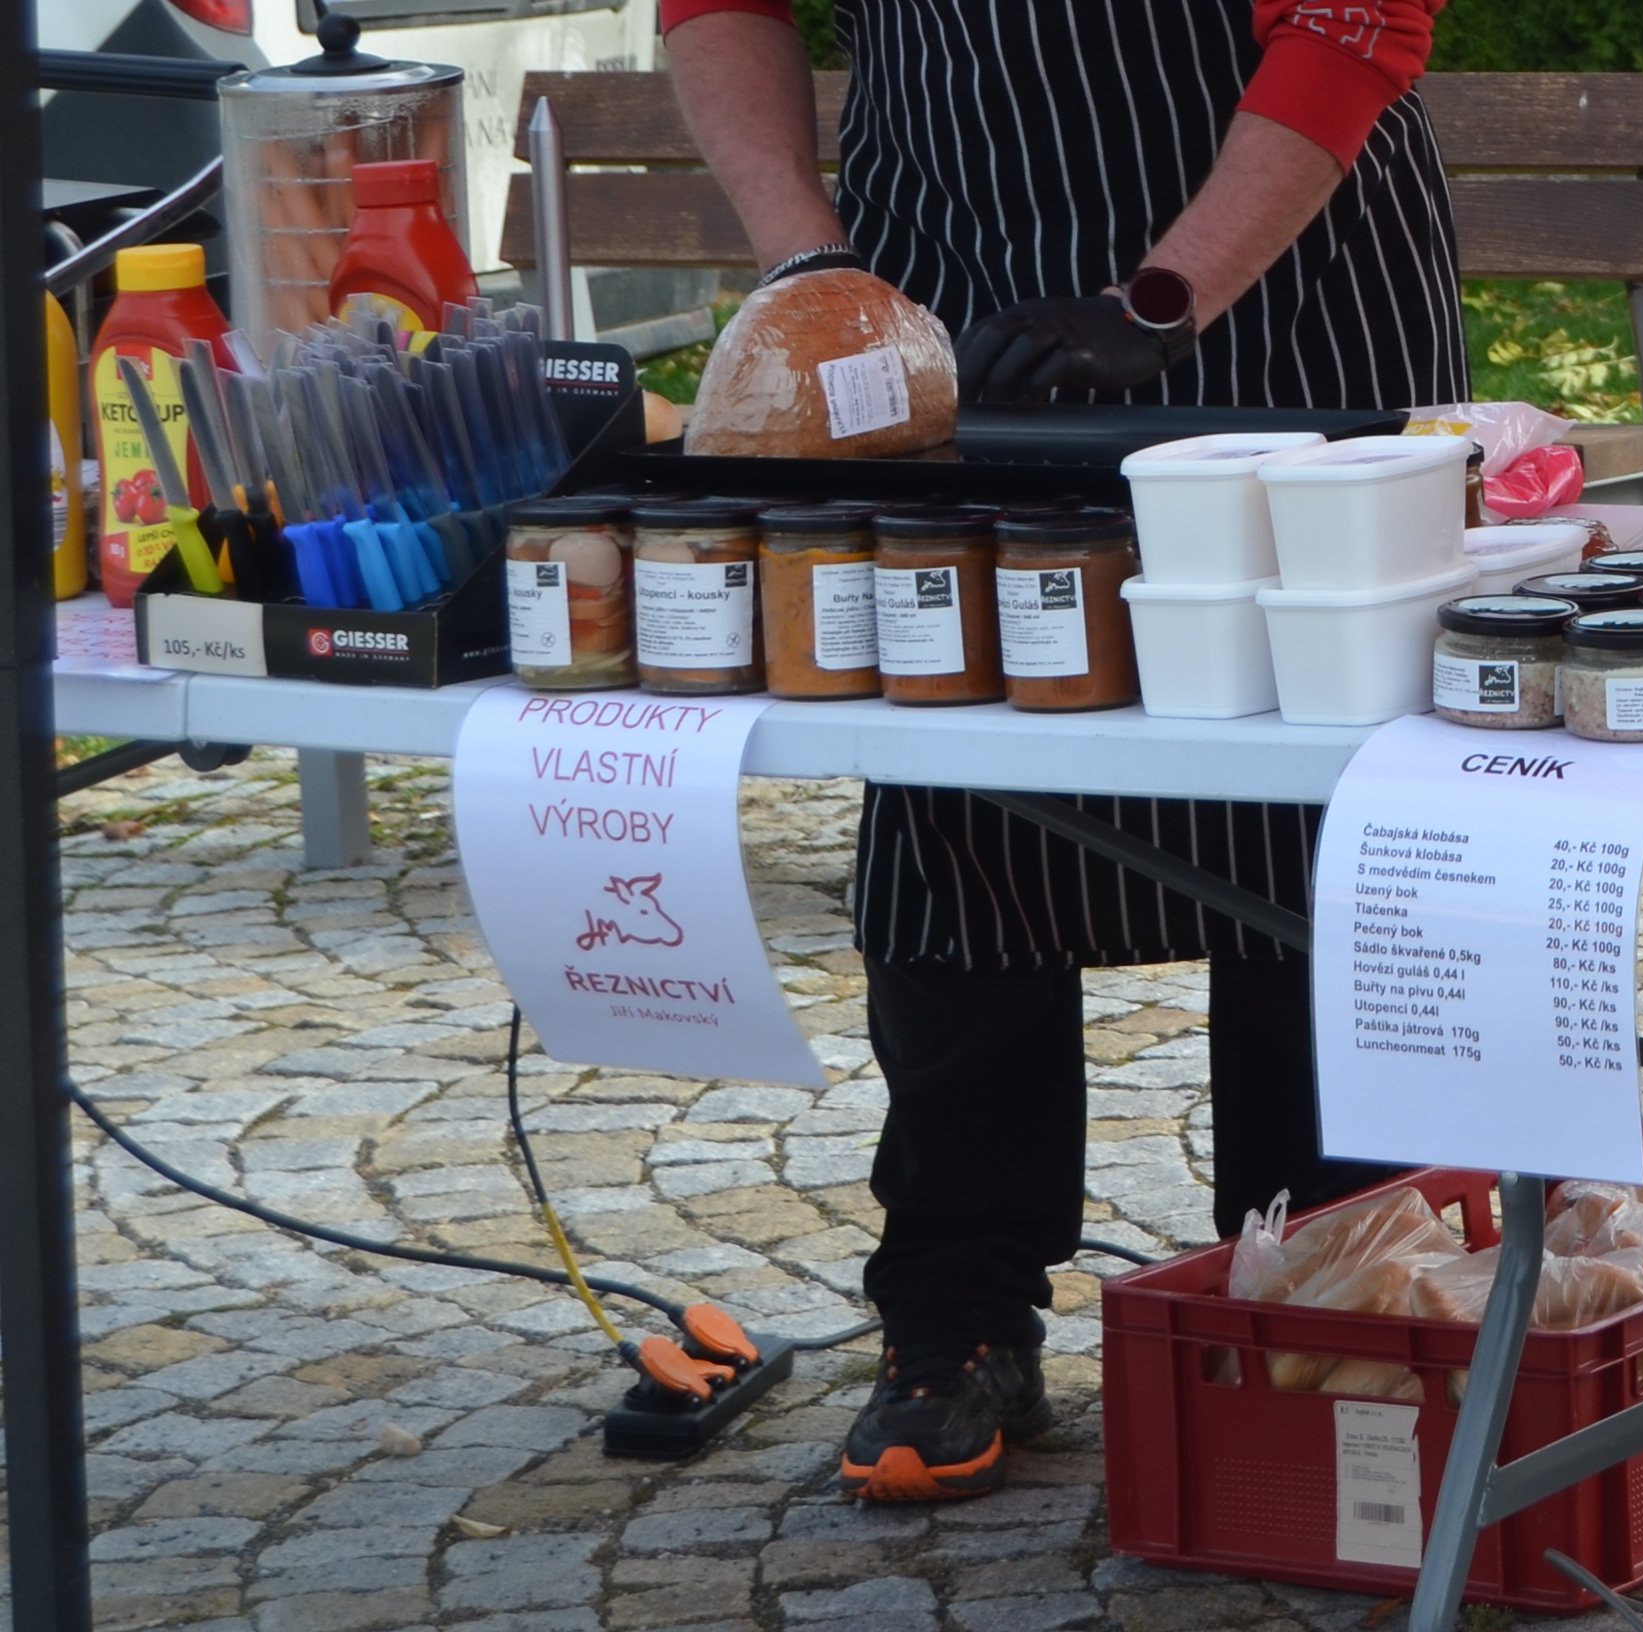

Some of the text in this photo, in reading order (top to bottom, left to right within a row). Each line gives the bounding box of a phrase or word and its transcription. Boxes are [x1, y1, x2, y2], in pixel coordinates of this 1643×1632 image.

[687, 589, 730, 602] kousky
[163, 639, 245, 659] 105,- Kč/ks
[333, 629, 409, 651] GIESSER
[518, 697, 724, 733] PRODUKTY
[531, 746, 679, 788] VLASTNÍ
[1459, 752, 1577, 781] CENÍK
[529, 798, 675, 845] VÝROBY
[1363, 823, 1469, 845] Čabajská klobása
[1359, 842, 1463, 863] Šunková klobása
[1554, 838, 1630, 859] 40,- Kč 100g
[1357, 863, 1366, 876] S
[1434, 868, 1496, 886] česnekem
[1550, 858, 1626, 878] 20,- Kč 100g
[1355, 882, 1419, 900] Uzený bok
[1548, 877, 1625, 898] 20,- Kč 100g
[1354, 902, 1409, 919] Tlačenka
[1547, 897, 1624, 918] 25,- Kč 100g
[1353, 921, 1424, 939] Pečený bok
[1548, 917, 1624, 938] 20,- Kč 100g
[1353, 940, 1482, 965] Sádlo škvařené 0,5kg
[1545, 937, 1622, 958] 20,- Kč 100g
[1353, 960, 1394, 976] Hovězí
[1397, 961, 1431, 979] guláš
[1433, 966, 1460, 981] 0,44
[1552, 957, 1616, 975] 80,- Kč /ks
[564, 963, 736, 1006] ŘEZNICTVÍ
[1353, 979, 1388, 997] Buřty
[1391, 984, 1404, 997] na
[1406, 982, 1435, 1001] pivu
[1550, 976, 1620, 995] 110,- Kč /ks
[1354, 999, 1408, 1017] Utopenci
[1553, 996, 1617, 1014] 90,- Kč /ks
[609, 1004, 720, 1028] Jiří Makovský
[1554, 1015, 1619, 1033] 90,- Kč /ks
[1355, 1018, 1480, 1042] Paštika játrová 170g
[1356, 1037, 1482, 1062] Luncheonmeat 175g
[1556, 1035, 1621, 1053] 50,- Kč /ks
[1558, 1054, 1623, 1072] 50,- Kč /ks
